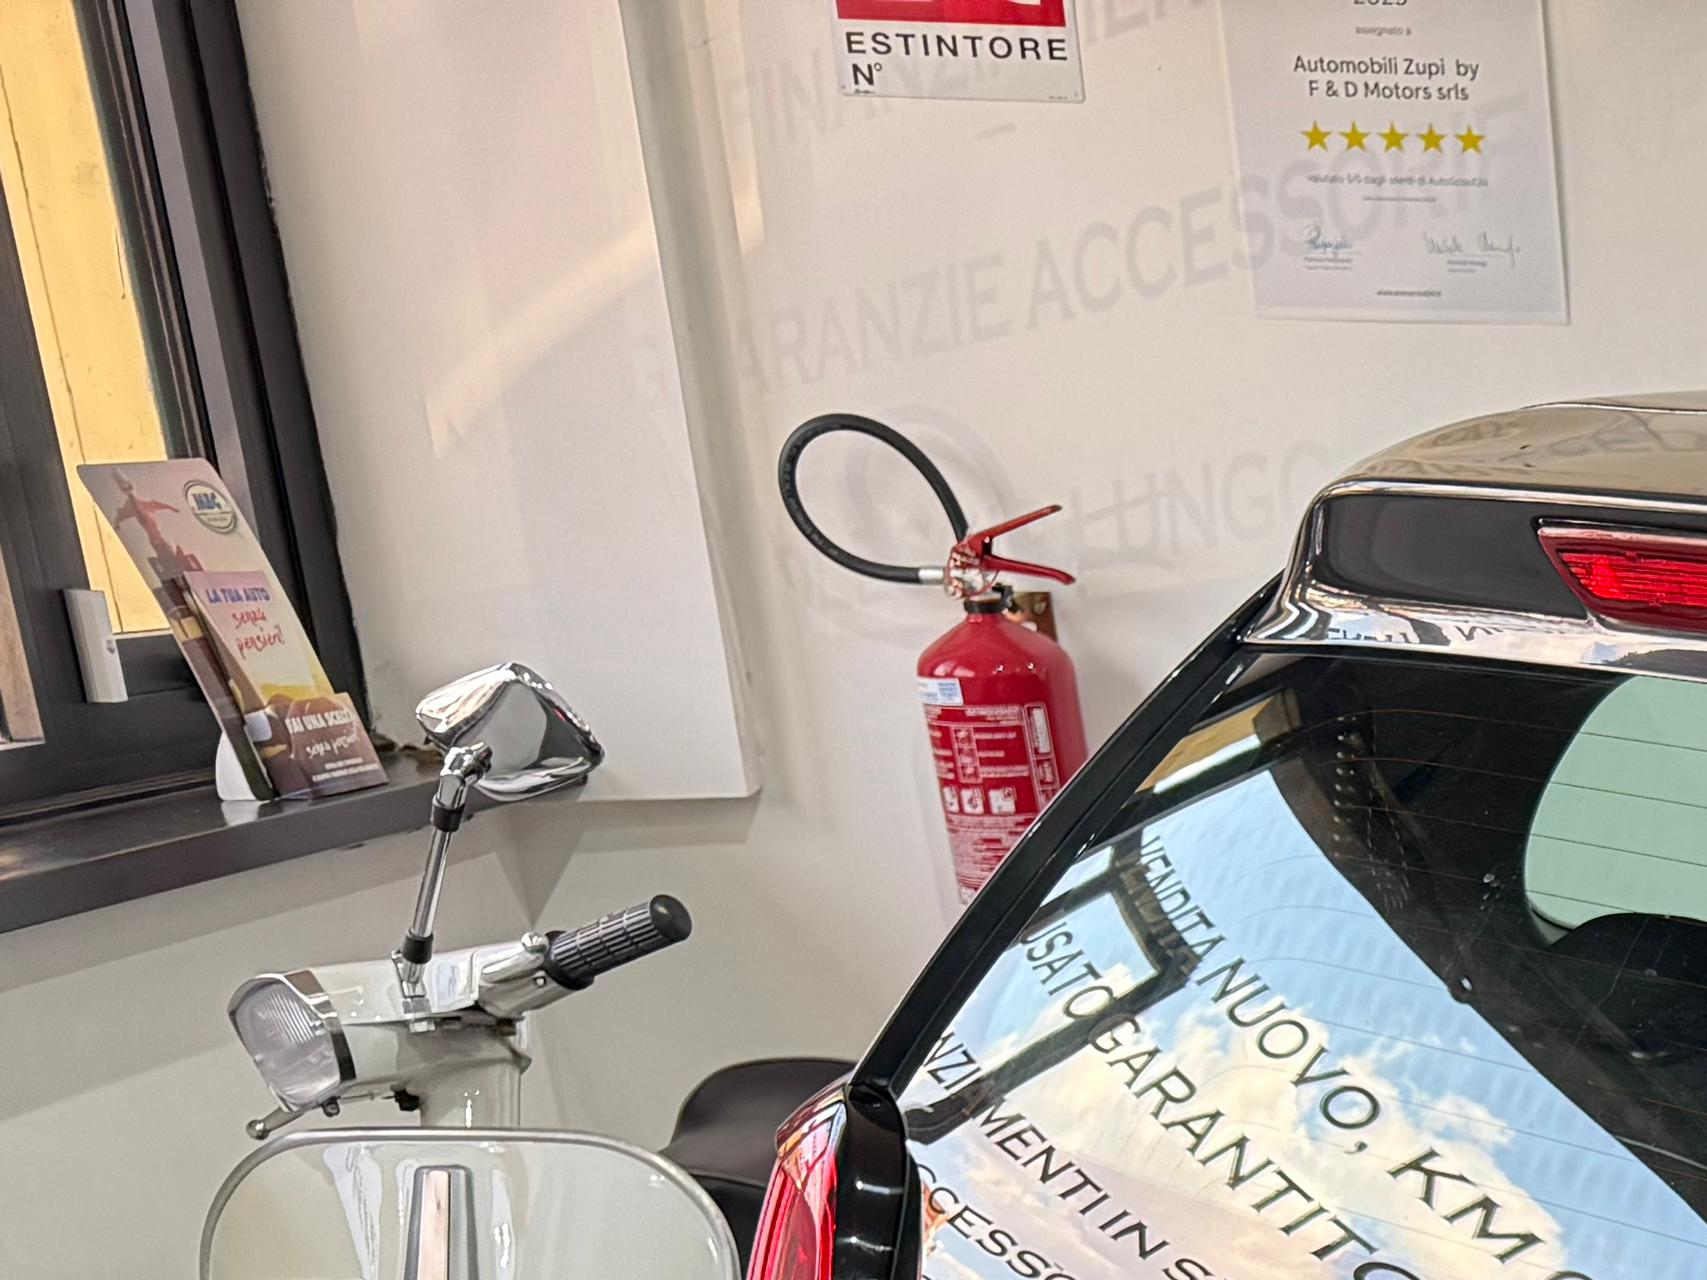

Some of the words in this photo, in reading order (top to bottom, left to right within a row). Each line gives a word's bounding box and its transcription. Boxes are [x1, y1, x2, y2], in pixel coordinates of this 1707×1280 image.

[845, 31, 1069, 61] ESTINTORE
[1293, 55, 1399, 75] Automobili
[1403, 57, 1445, 80] Zupi
[1456, 58, 1480, 81] by
[1308, 80, 1319, 97] F
[1326, 81, 1340, 98] &
[1344, 81, 1358, 98] D
[1364, 82, 1433, 100] Motors
[1437, 83, 1470, 101] srls
[1018, 920, 1115, 1019] USATO
[1141, 835, 1227, 963] VENDITA
[1195, 957, 1382, 1156] NUOVO,
[1387, 1147, 1546, 1265] KM
[1097, 1207, 1170, 1261] IN
